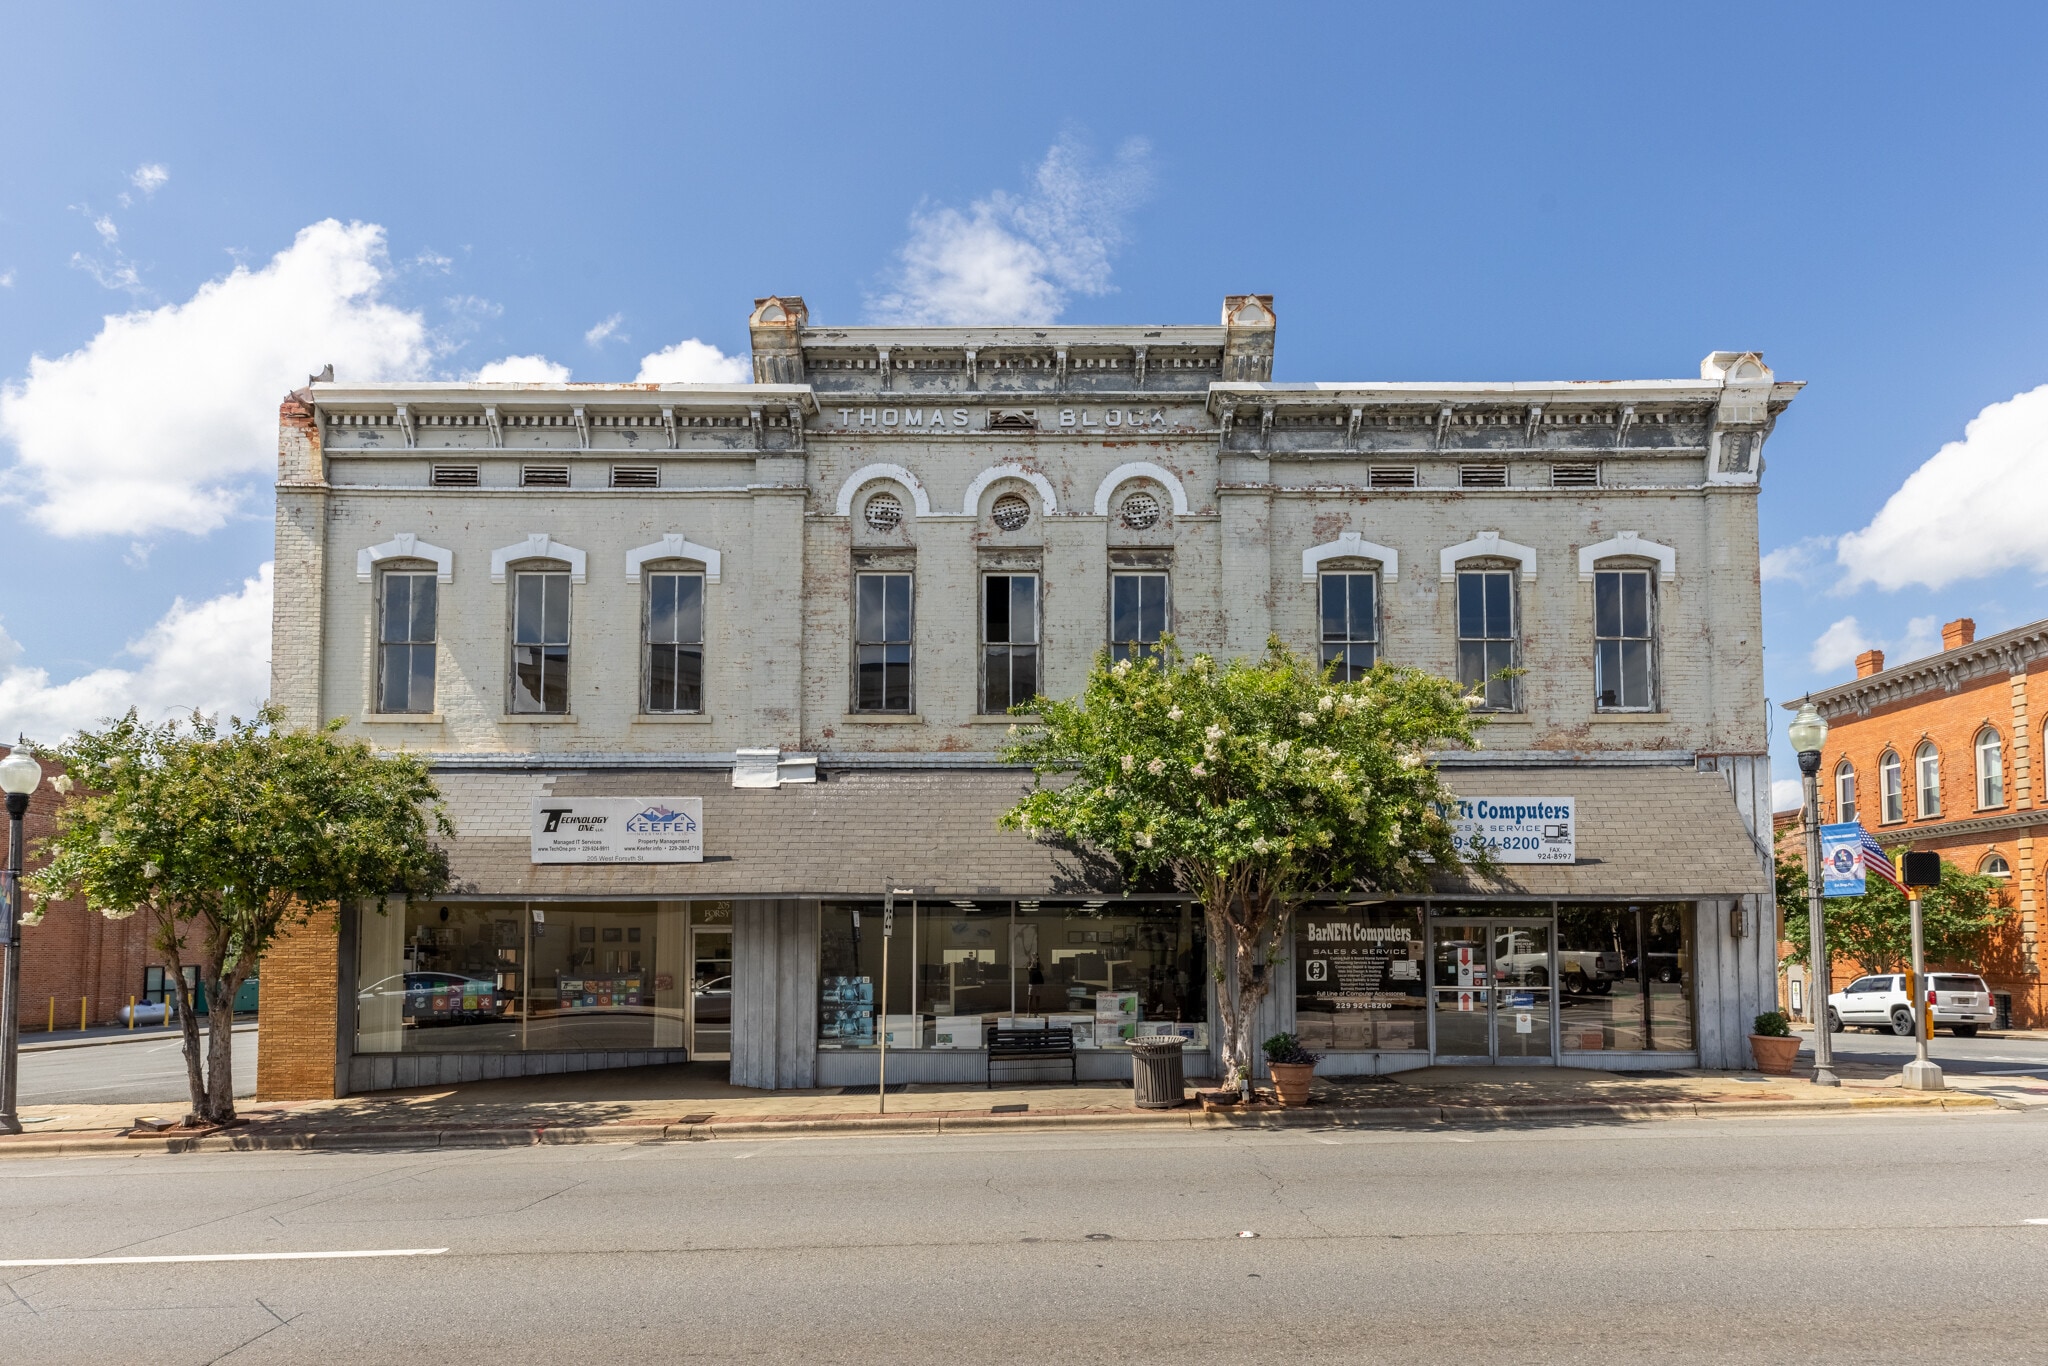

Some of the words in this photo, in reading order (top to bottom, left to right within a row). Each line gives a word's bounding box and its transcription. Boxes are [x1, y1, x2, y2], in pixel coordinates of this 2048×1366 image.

[837, 408, 970, 427] THOMAS
[539, 809, 608, 832] TECHNOLOGY
[1478, 800, 1570, 824] Computers
[627, 823, 696, 832] KEEFER
[1308, 923, 1352, 941] BarNETt
[1353, 923, 1412, 947] Computers
